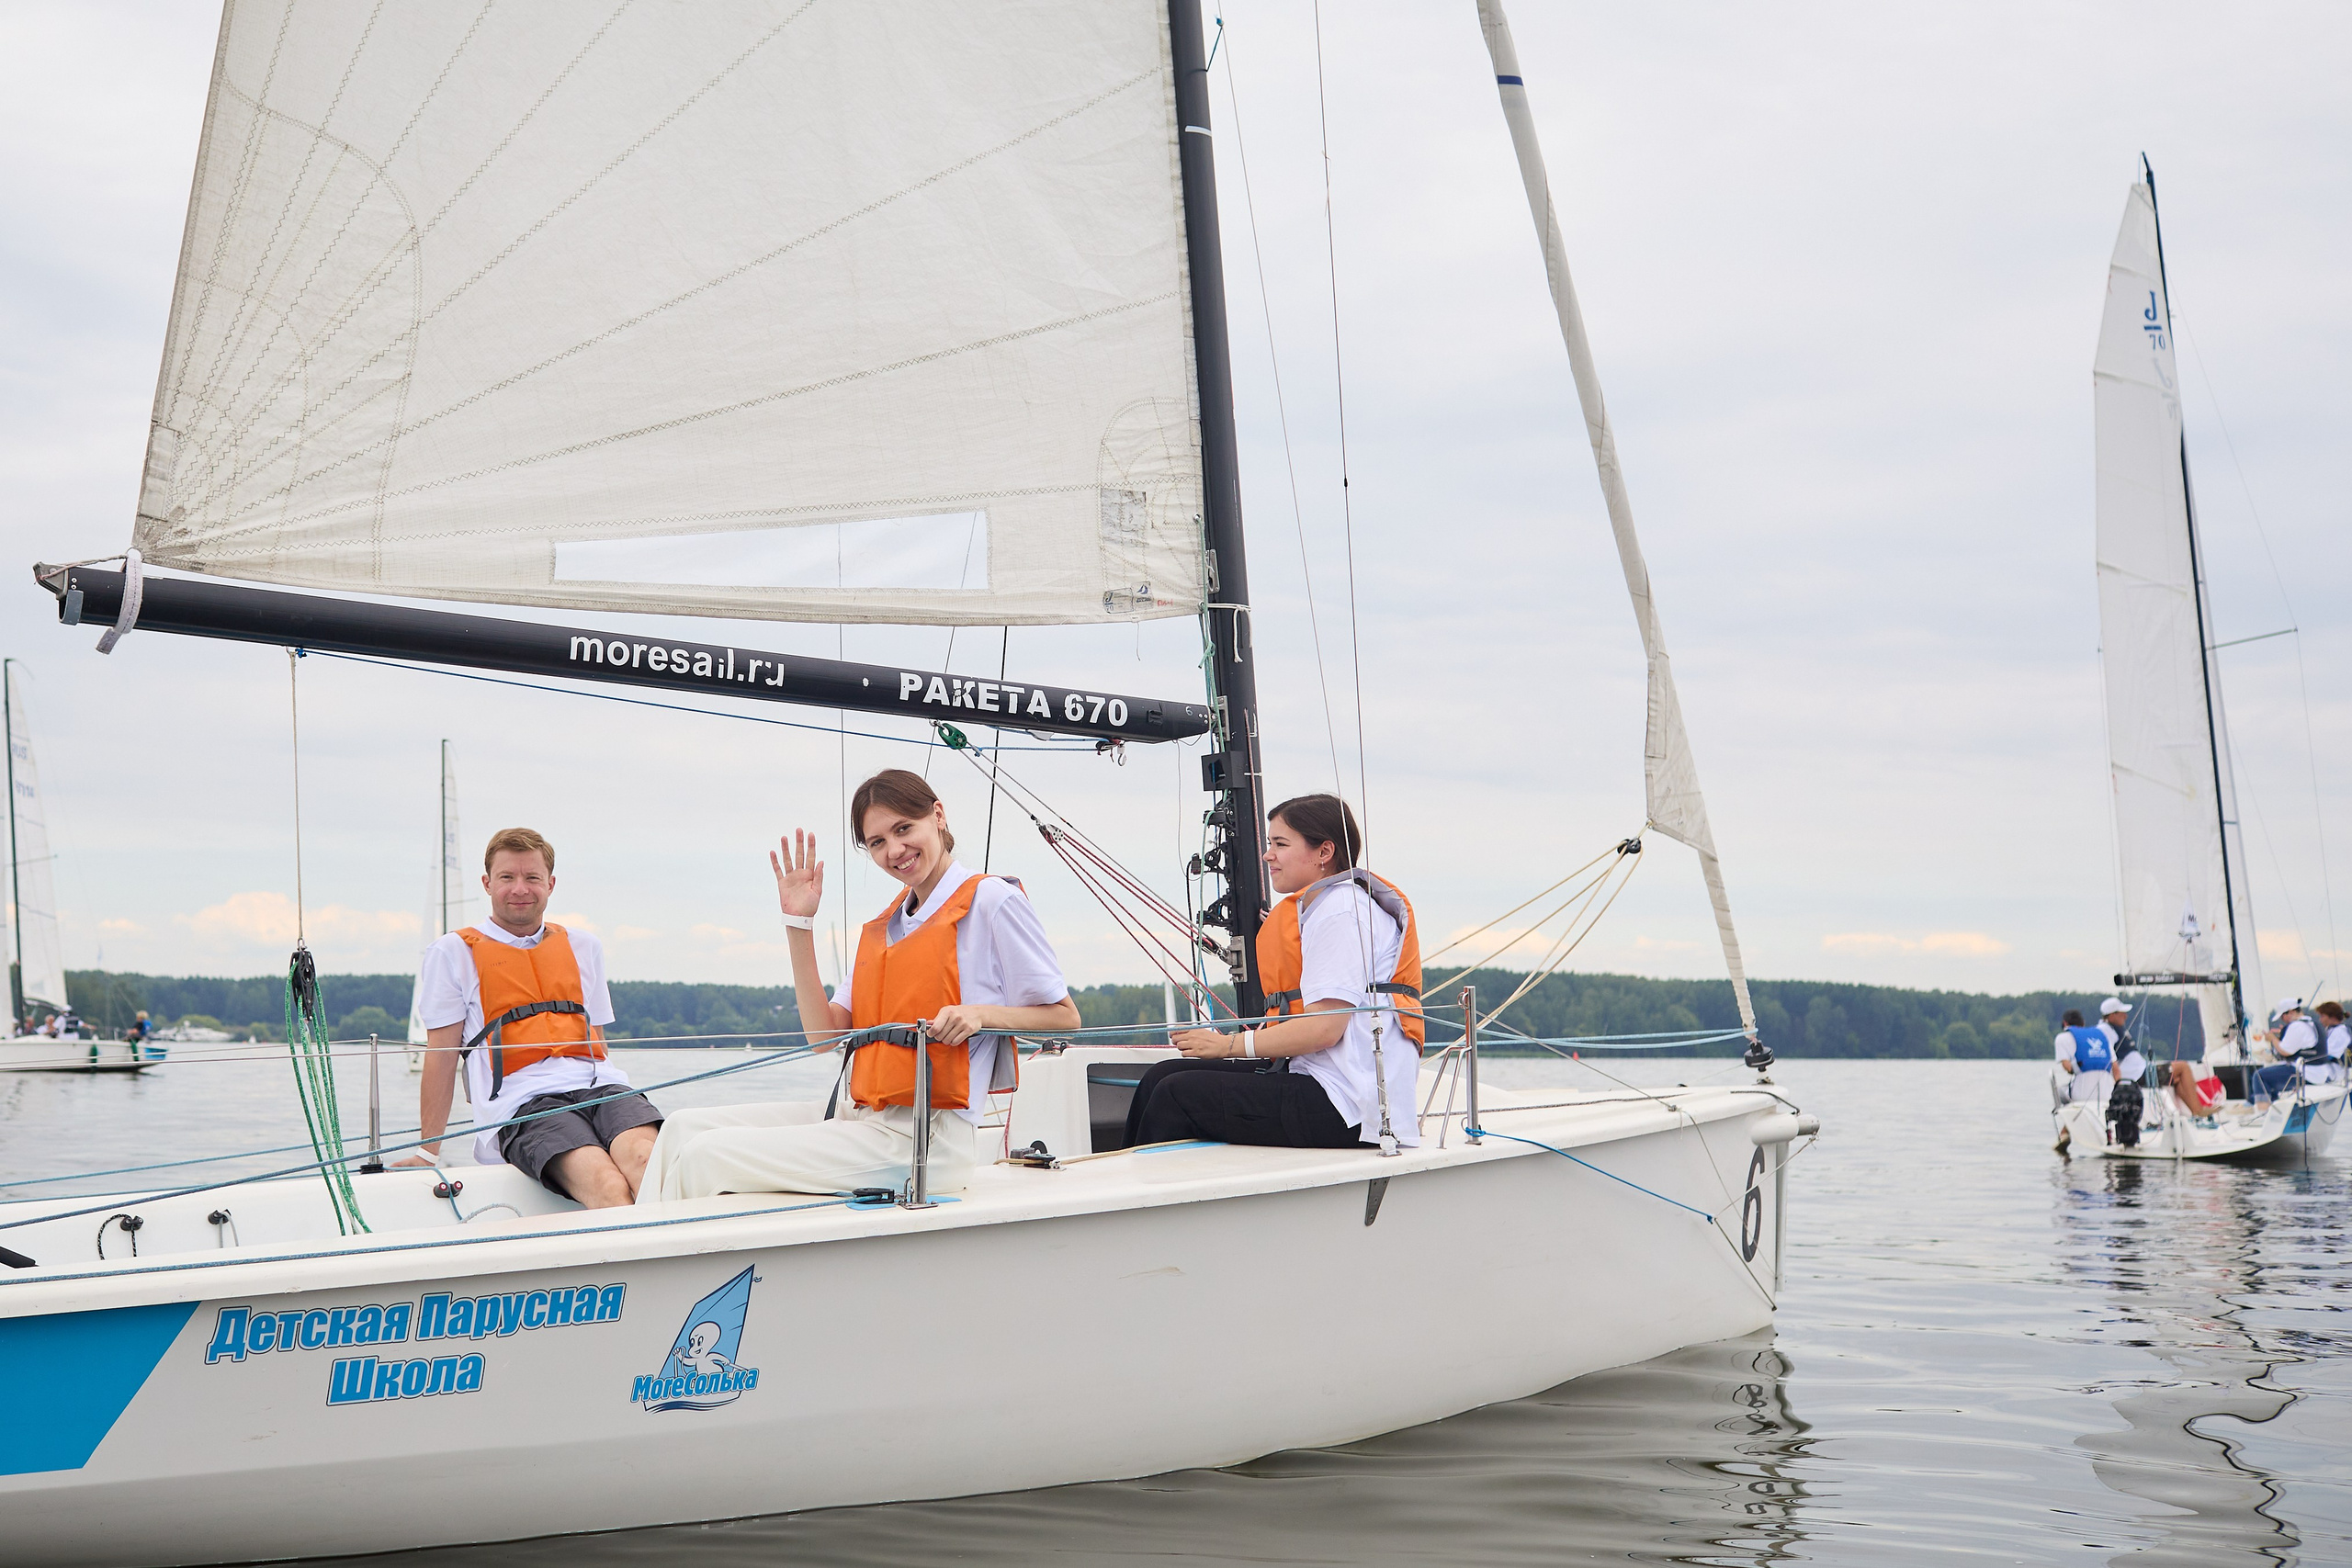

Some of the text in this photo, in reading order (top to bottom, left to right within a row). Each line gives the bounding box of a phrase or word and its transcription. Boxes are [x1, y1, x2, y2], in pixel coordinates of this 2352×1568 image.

[2143, 290, 2158, 321] J
[2149, 333, 2166, 351] 70
[569, 636, 786, 687] moresail.ru
[899, 671, 1129, 728] РАКЕТА 670
[1185, 705, 1193, 716] 6
[1742, 1145, 1765, 1263] 6
[205, 1282, 627, 1365] Детская Парусная
[326, 1352, 486, 1406] Школа
